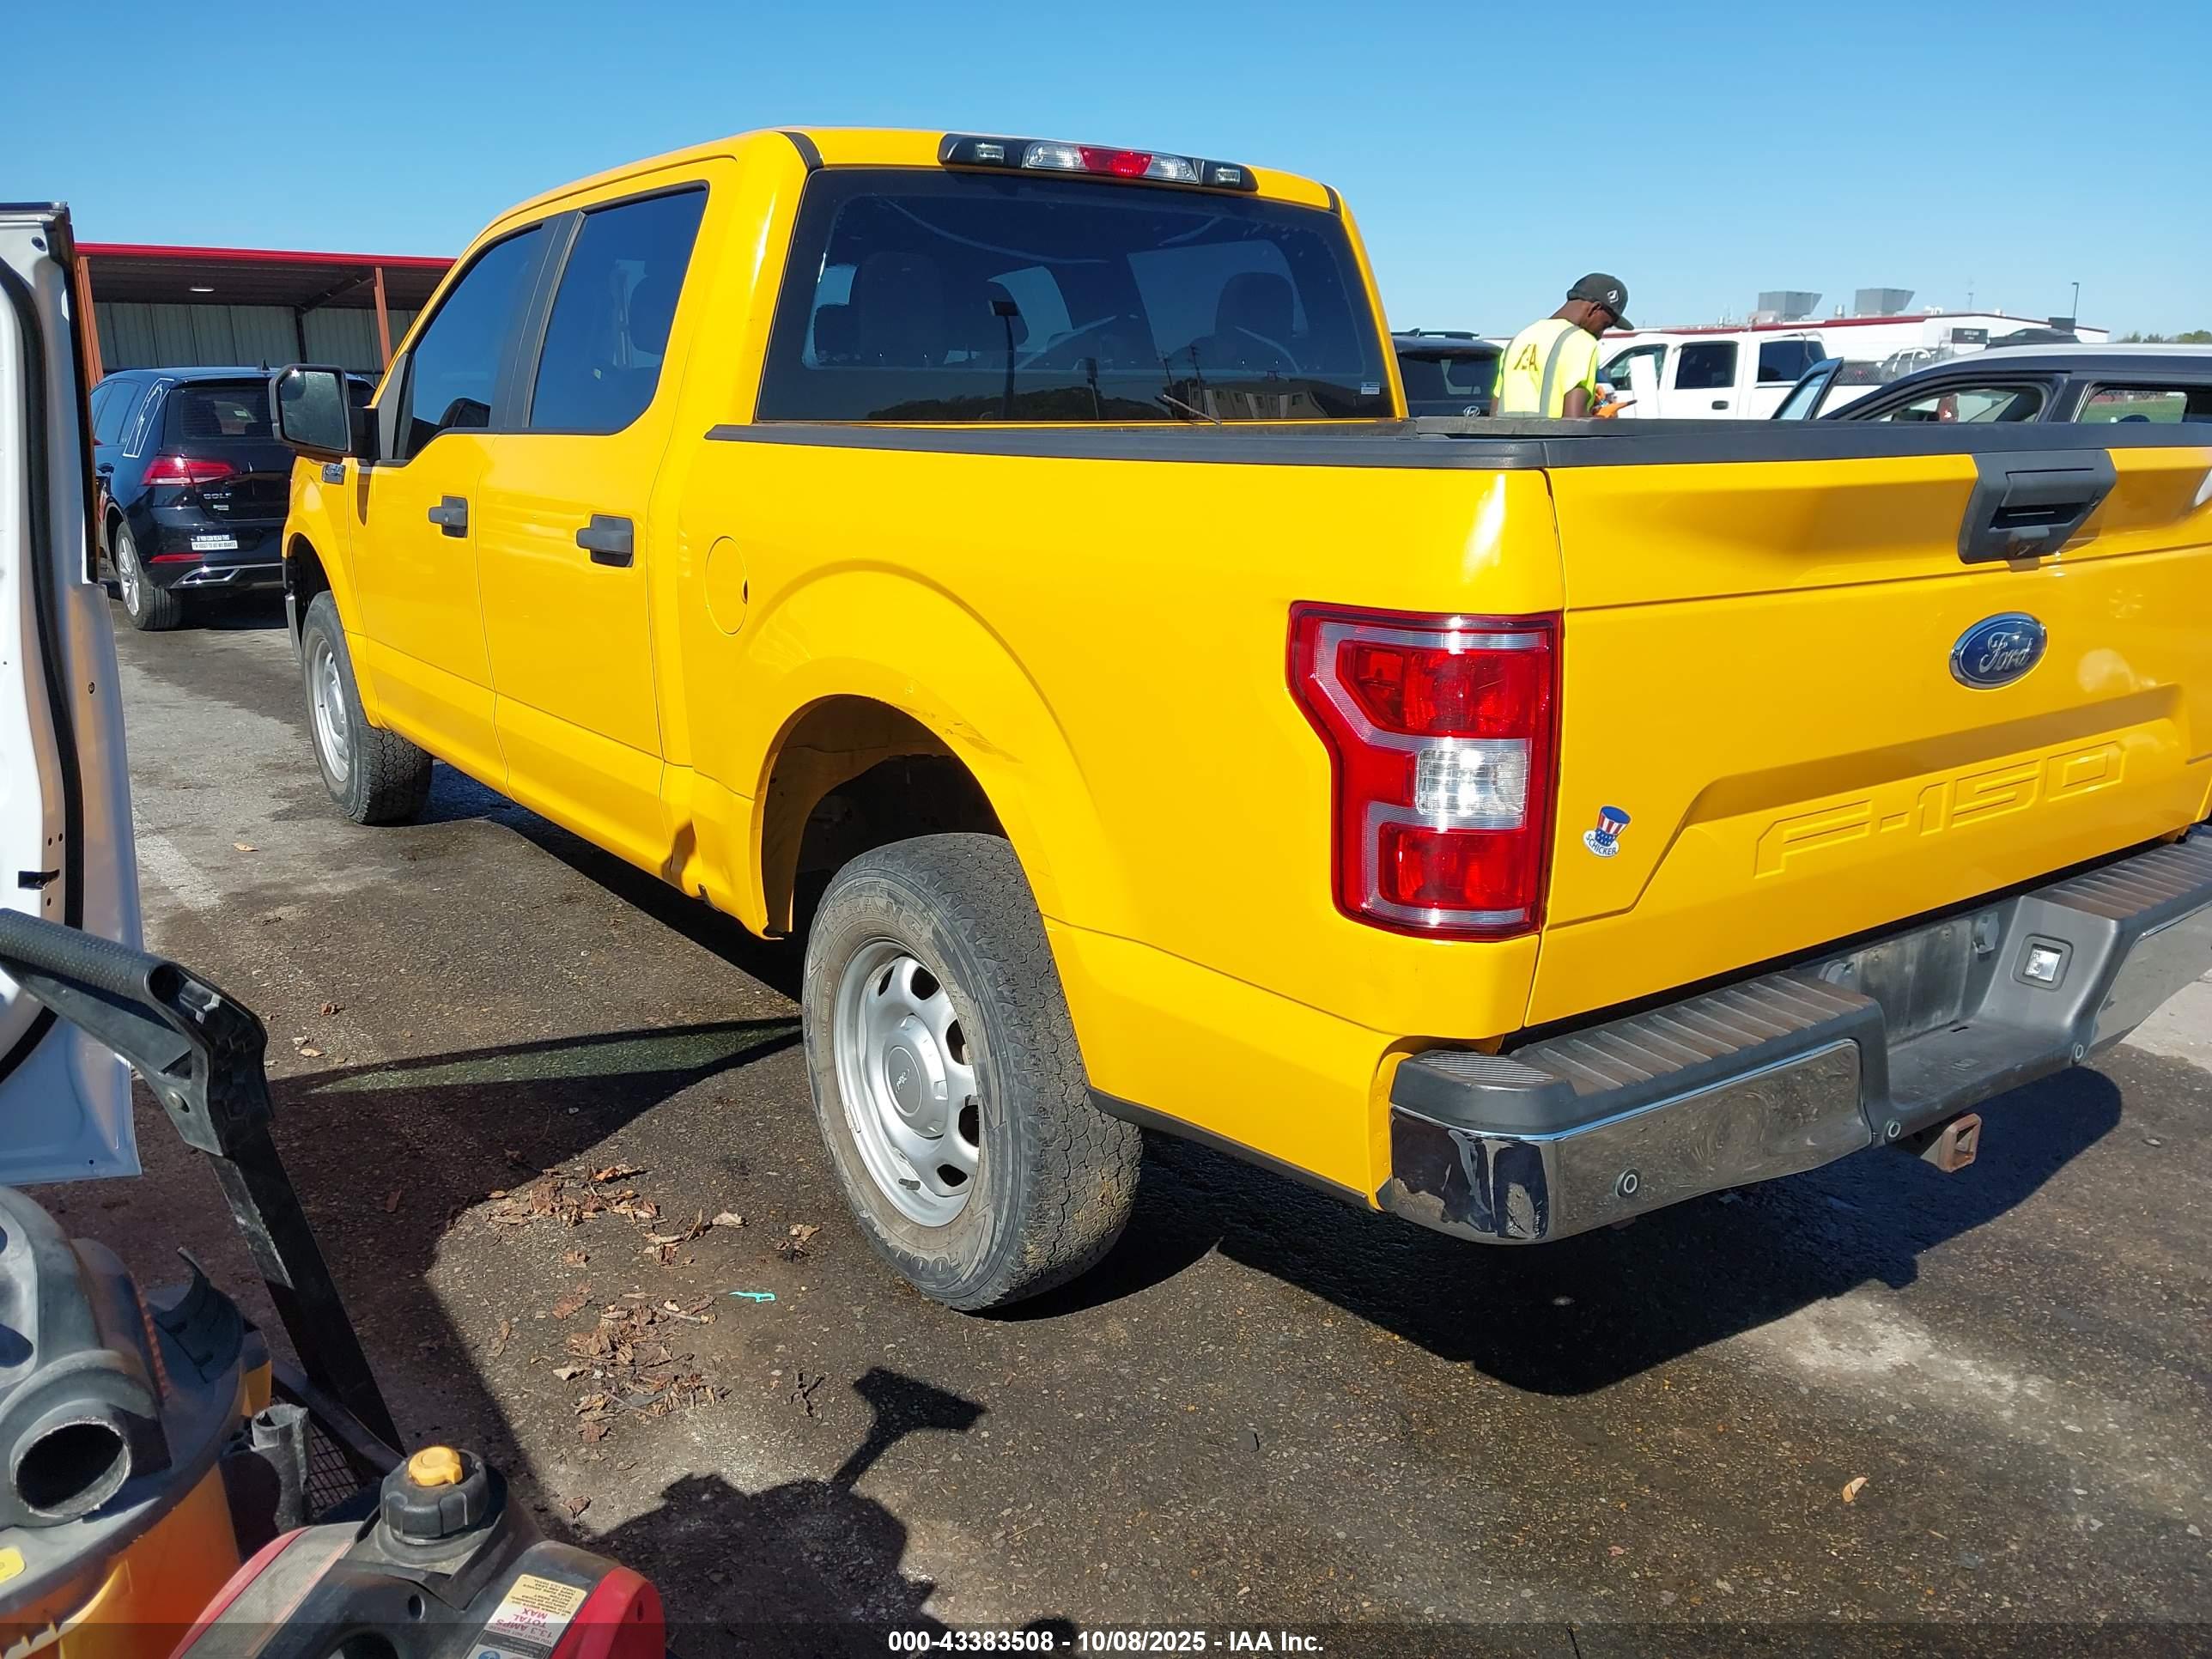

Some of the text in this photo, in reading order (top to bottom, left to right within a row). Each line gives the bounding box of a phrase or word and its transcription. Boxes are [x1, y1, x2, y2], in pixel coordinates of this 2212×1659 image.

[1979, 631, 2033, 673] Ford
[1754, 741, 2127, 879] F-150
[1586, 833, 1617, 855] SCHICKER
[513, 1613, 548, 1628] TOTAL
[521, 1607, 548, 1620] MAX
[495, 1619, 554, 1638] 13.3 AMPS
